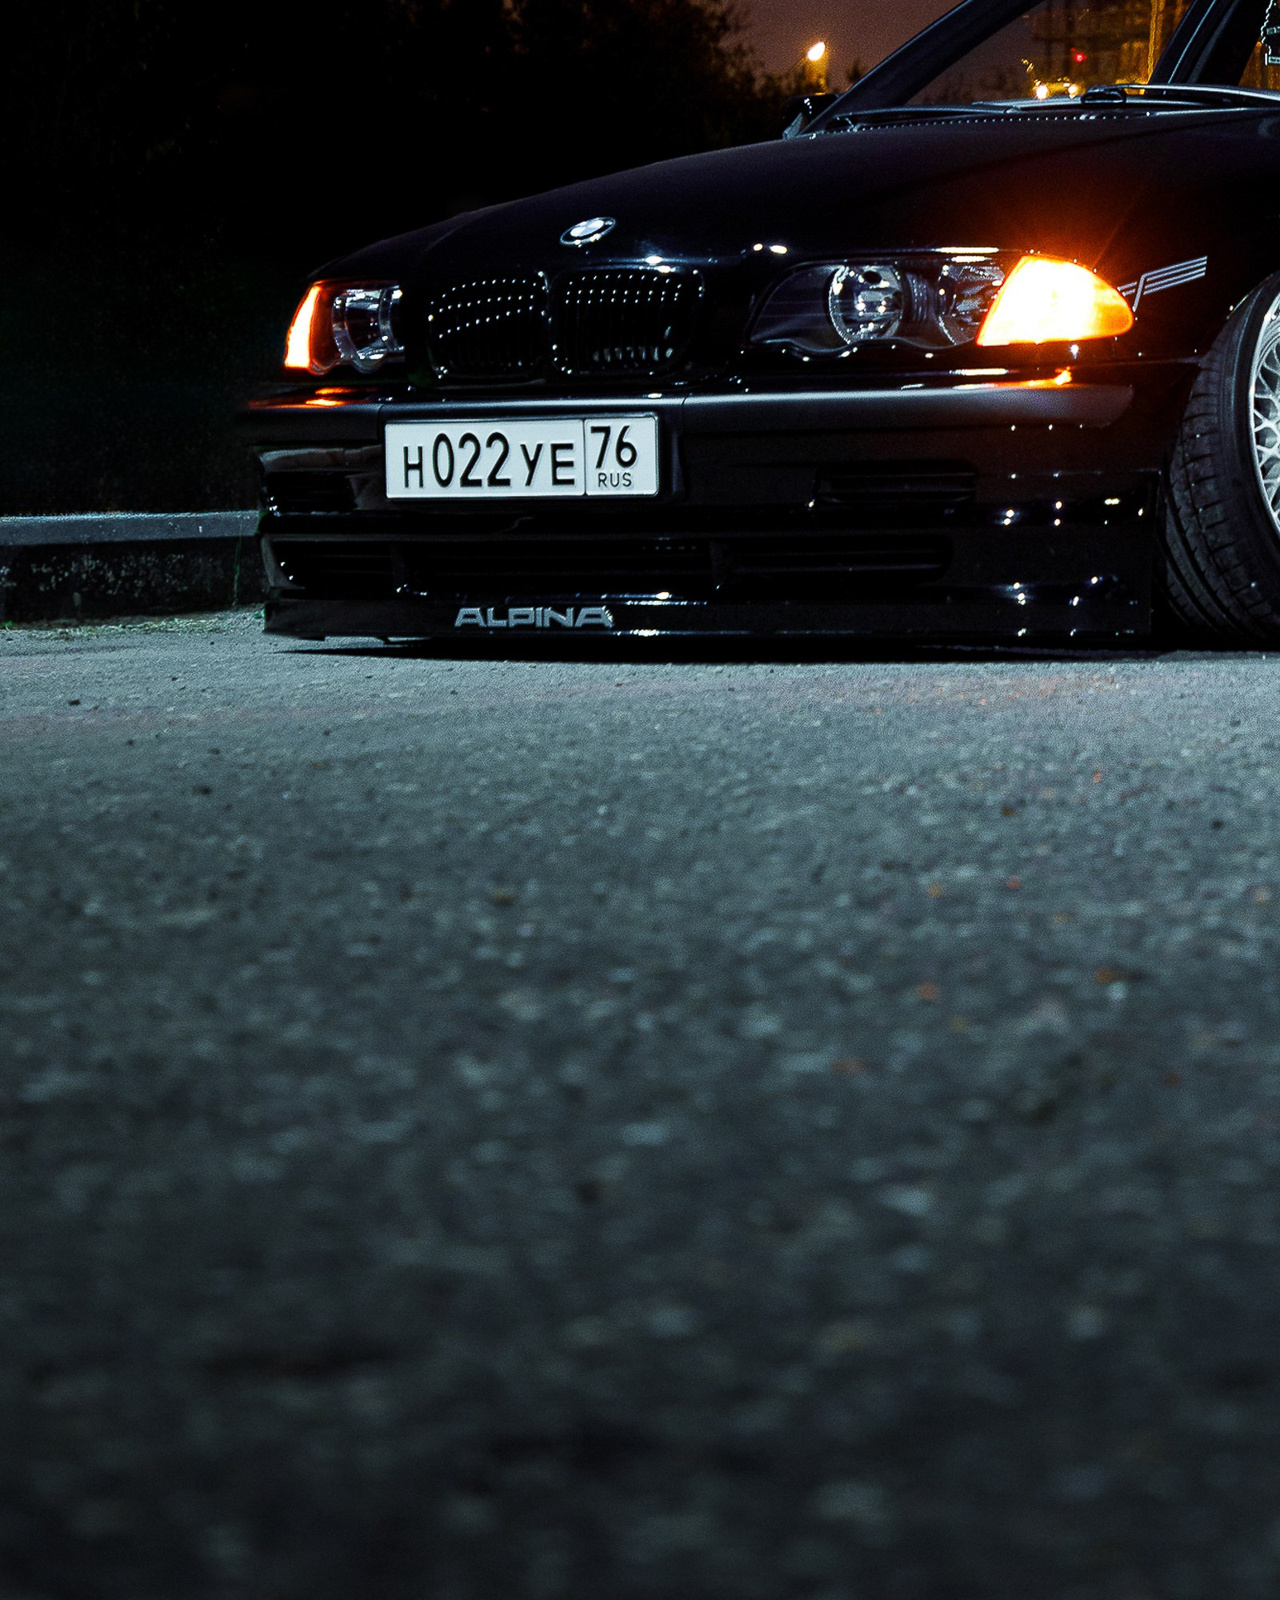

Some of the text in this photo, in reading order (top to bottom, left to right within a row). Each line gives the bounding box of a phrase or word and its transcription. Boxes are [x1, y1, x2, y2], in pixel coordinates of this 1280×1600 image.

[591, 425, 637, 468] 76
[598, 472, 632, 487] RUS
[454, 606, 614, 627] ALPINA
